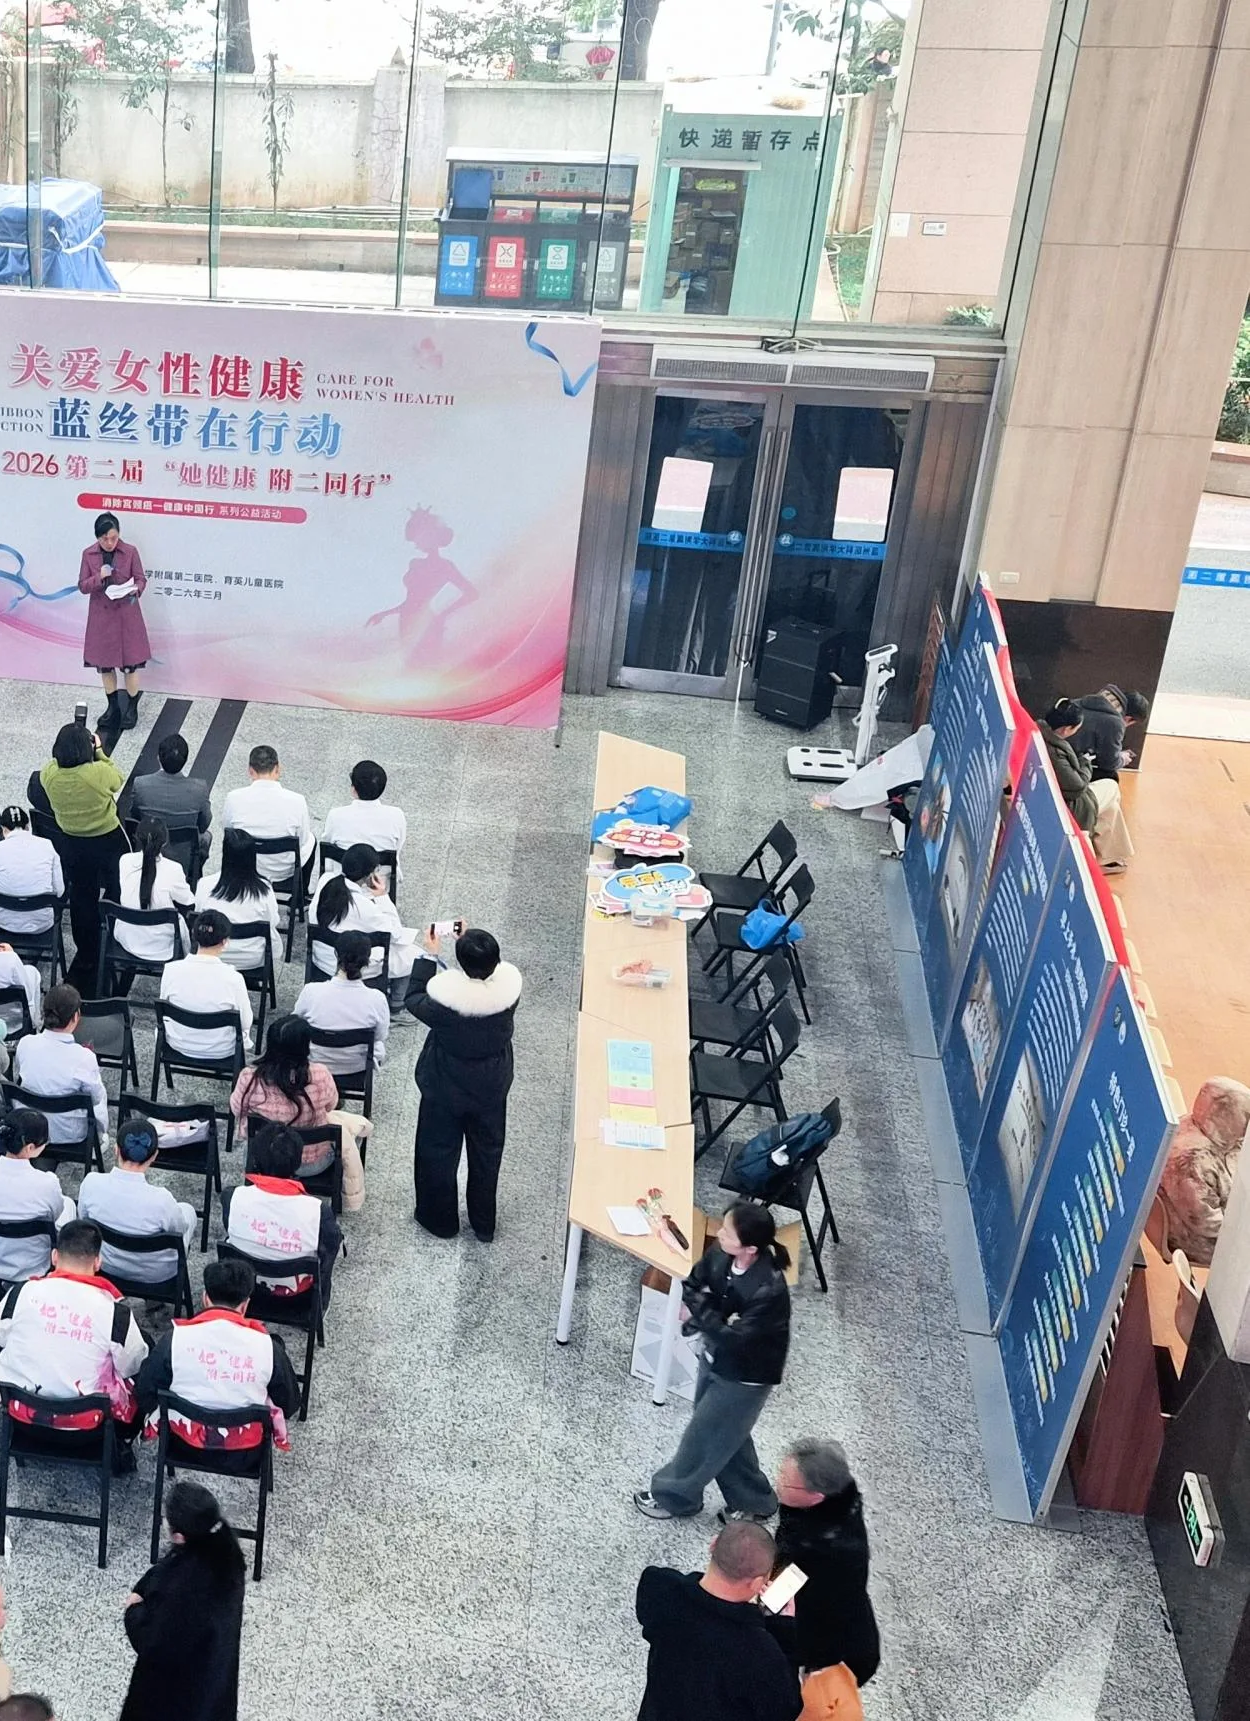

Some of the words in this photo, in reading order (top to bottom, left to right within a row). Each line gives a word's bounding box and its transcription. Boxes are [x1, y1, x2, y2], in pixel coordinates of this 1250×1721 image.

[679, 127, 820, 151] 快递暂存点
[11, 343, 304, 400] 关爱女性健康
[317, 373, 357, 386] CARE
[363, 375, 395, 387] FOR
[316, 388, 387, 401] WOMEN'S
[394, 392, 455, 406] HEALTH
[47, 397, 344, 458] 蓝丝带在行动
[219, 504, 282, 520] 系列公益活动
[145, 569, 284, 589] 学附属第二医院、育英儿童医院
[153, 586, 222, 601] 二零二六年三月
